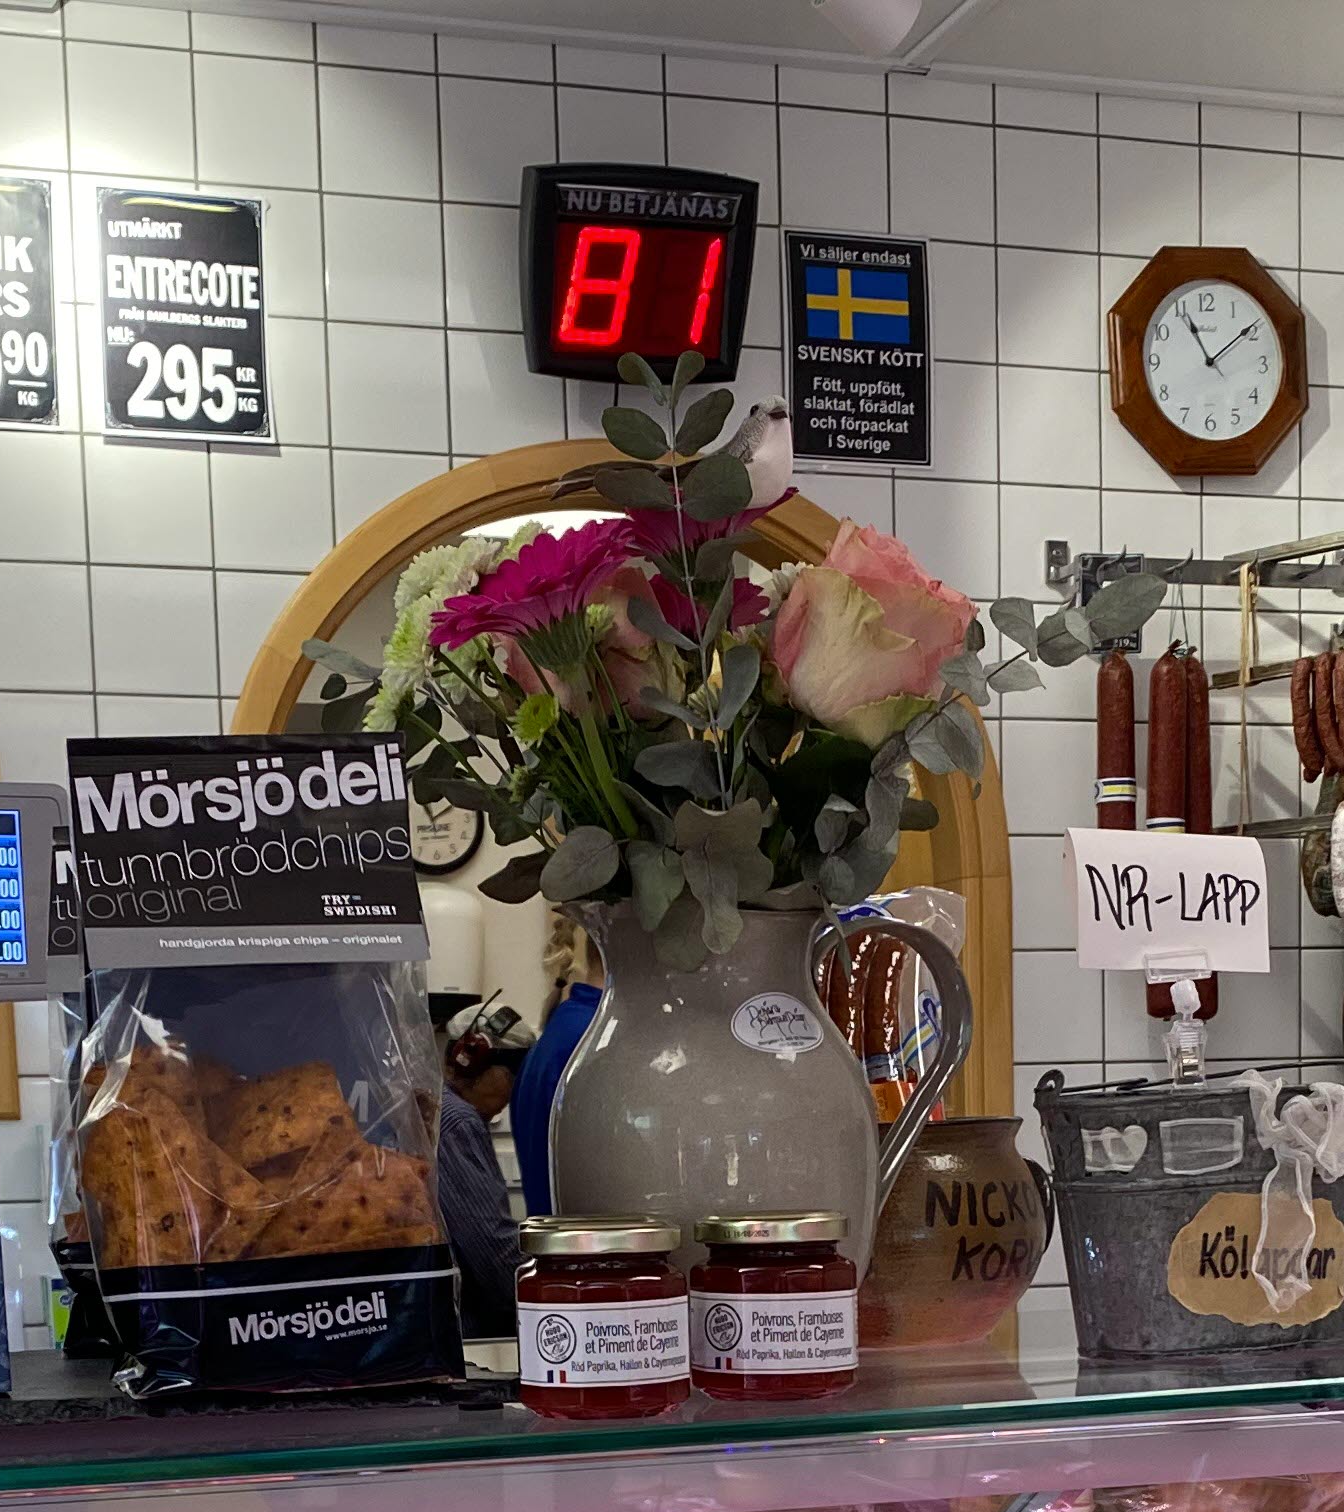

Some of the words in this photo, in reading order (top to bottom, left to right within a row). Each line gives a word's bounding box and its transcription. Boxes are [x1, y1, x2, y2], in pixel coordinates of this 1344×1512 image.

[566, 190, 600, 212] NU
[609, 192, 729, 220] BETJÄNAS
[107, 216, 182, 240] UTMÄRKT
[800, 244, 816, 259] Vi
[818, 246, 859, 264] säljer
[862, 248, 911, 266] endast
[106, 254, 260, 309] ENTRECOTE
[797, 345, 877, 367] SVENSKT
[879, 348, 924, 369] KÖTT
[126, 340, 236, 424] 295
[813, 376, 846, 396] Fött,
[849, 380, 905, 399] uppfött,
[804, 396, 856, 416] slaktat,
[858, 398, 915, 416] förädlat
[810, 415, 837, 430] och
[840, 416, 909, 436] förpackat
[836, 435, 891, 453] Sverige
[80, 822, 411, 887] tunnbrödchips
[86, 875, 242, 923] original
[321, 894, 350, 906] TRY
[1084, 862, 1261, 932] NR-LAPP
[323, 904, 398, 917] SWEDISH!
[159, 937, 235, 949] handgjorda
[238, 936, 292, 948] krispiga
[293, 935, 329, 947] chips
[343, 934, 403, 946] originalet
[751, 1311, 796, 1328] Poivrons,
[798, 1310, 844, 1327] Framboises
[763, 1328, 798, 1343] Piment
[813, 1326, 845, 1344] Cayenne
